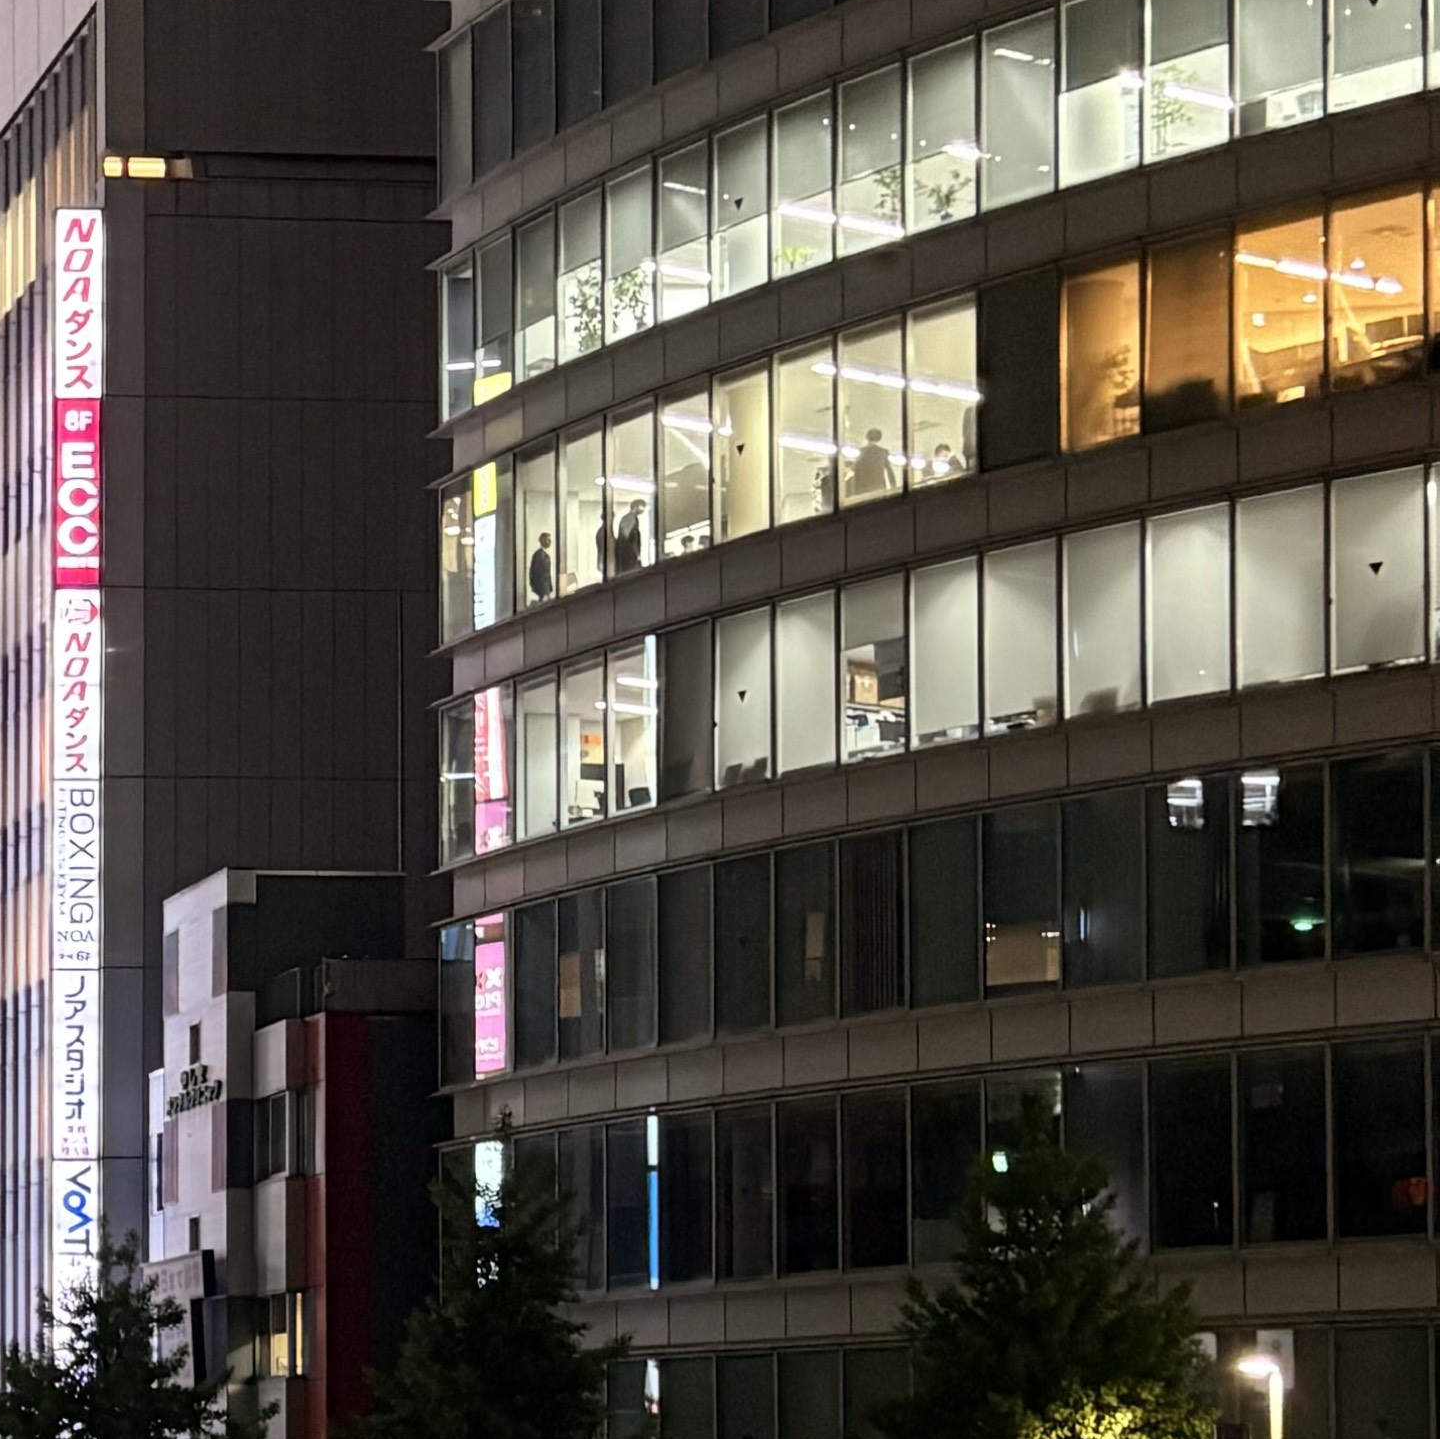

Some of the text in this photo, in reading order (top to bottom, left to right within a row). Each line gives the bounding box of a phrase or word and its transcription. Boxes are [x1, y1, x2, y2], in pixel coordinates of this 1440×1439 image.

[62, 217, 97, 391] NOAダンス
[56, 442, 100, 556] ECC
[63, 631, 92, 773] NOAダンス
[69, 788, 95, 925] BOXING
